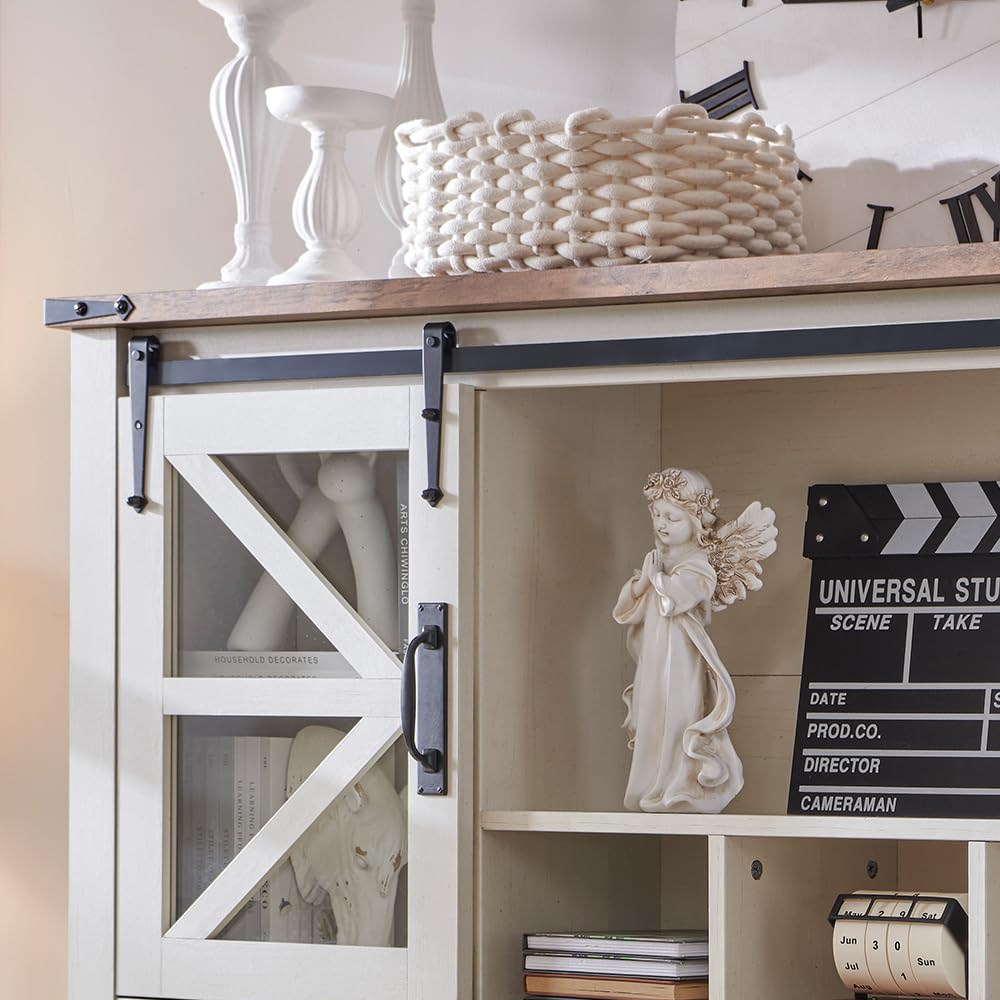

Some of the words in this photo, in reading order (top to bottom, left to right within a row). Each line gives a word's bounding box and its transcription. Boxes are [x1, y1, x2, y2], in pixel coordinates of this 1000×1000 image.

[400, 504, 408, 533] ARTS
[819, 578, 944, 604] UNIVERSAL
[830, 614, 892, 631] SCENE
[933, 614, 983, 630] TAKE
[214, 656, 266, 664] HOUSEHOLD
[268, 656, 319, 665] DECORATES
[810, 693, 847, 705] DATE
[807, 723, 881, 739] PROD.CO.
[804, 757, 880, 773] DIRECTOR
[801, 796, 897, 812] CAMERAMAN
[840, 936, 857, 945] Jun
[845, 962, 859, 970] Jul
[917, 958, 935, 966] Sun
